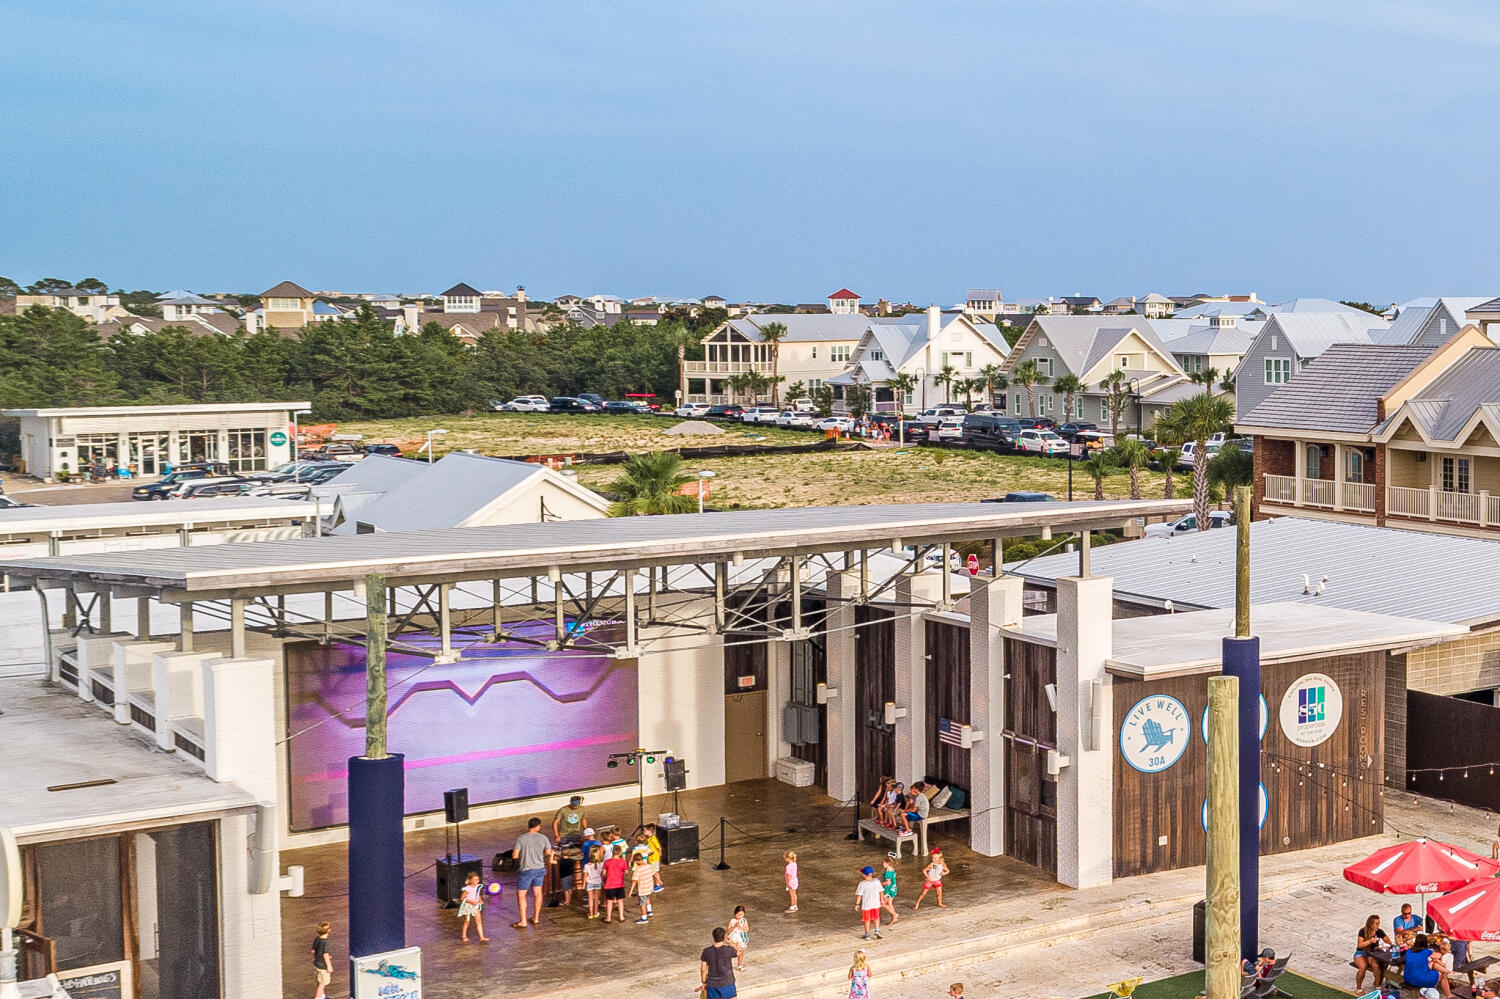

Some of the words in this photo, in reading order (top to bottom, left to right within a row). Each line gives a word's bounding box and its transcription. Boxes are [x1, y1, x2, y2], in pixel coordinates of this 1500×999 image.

[1129, 702, 1152, 726] LIVE
[1157, 700, 1182, 720] WELL
[1298, 701, 1326, 717] 850
[1148, 756, 1165, 767] 30A
